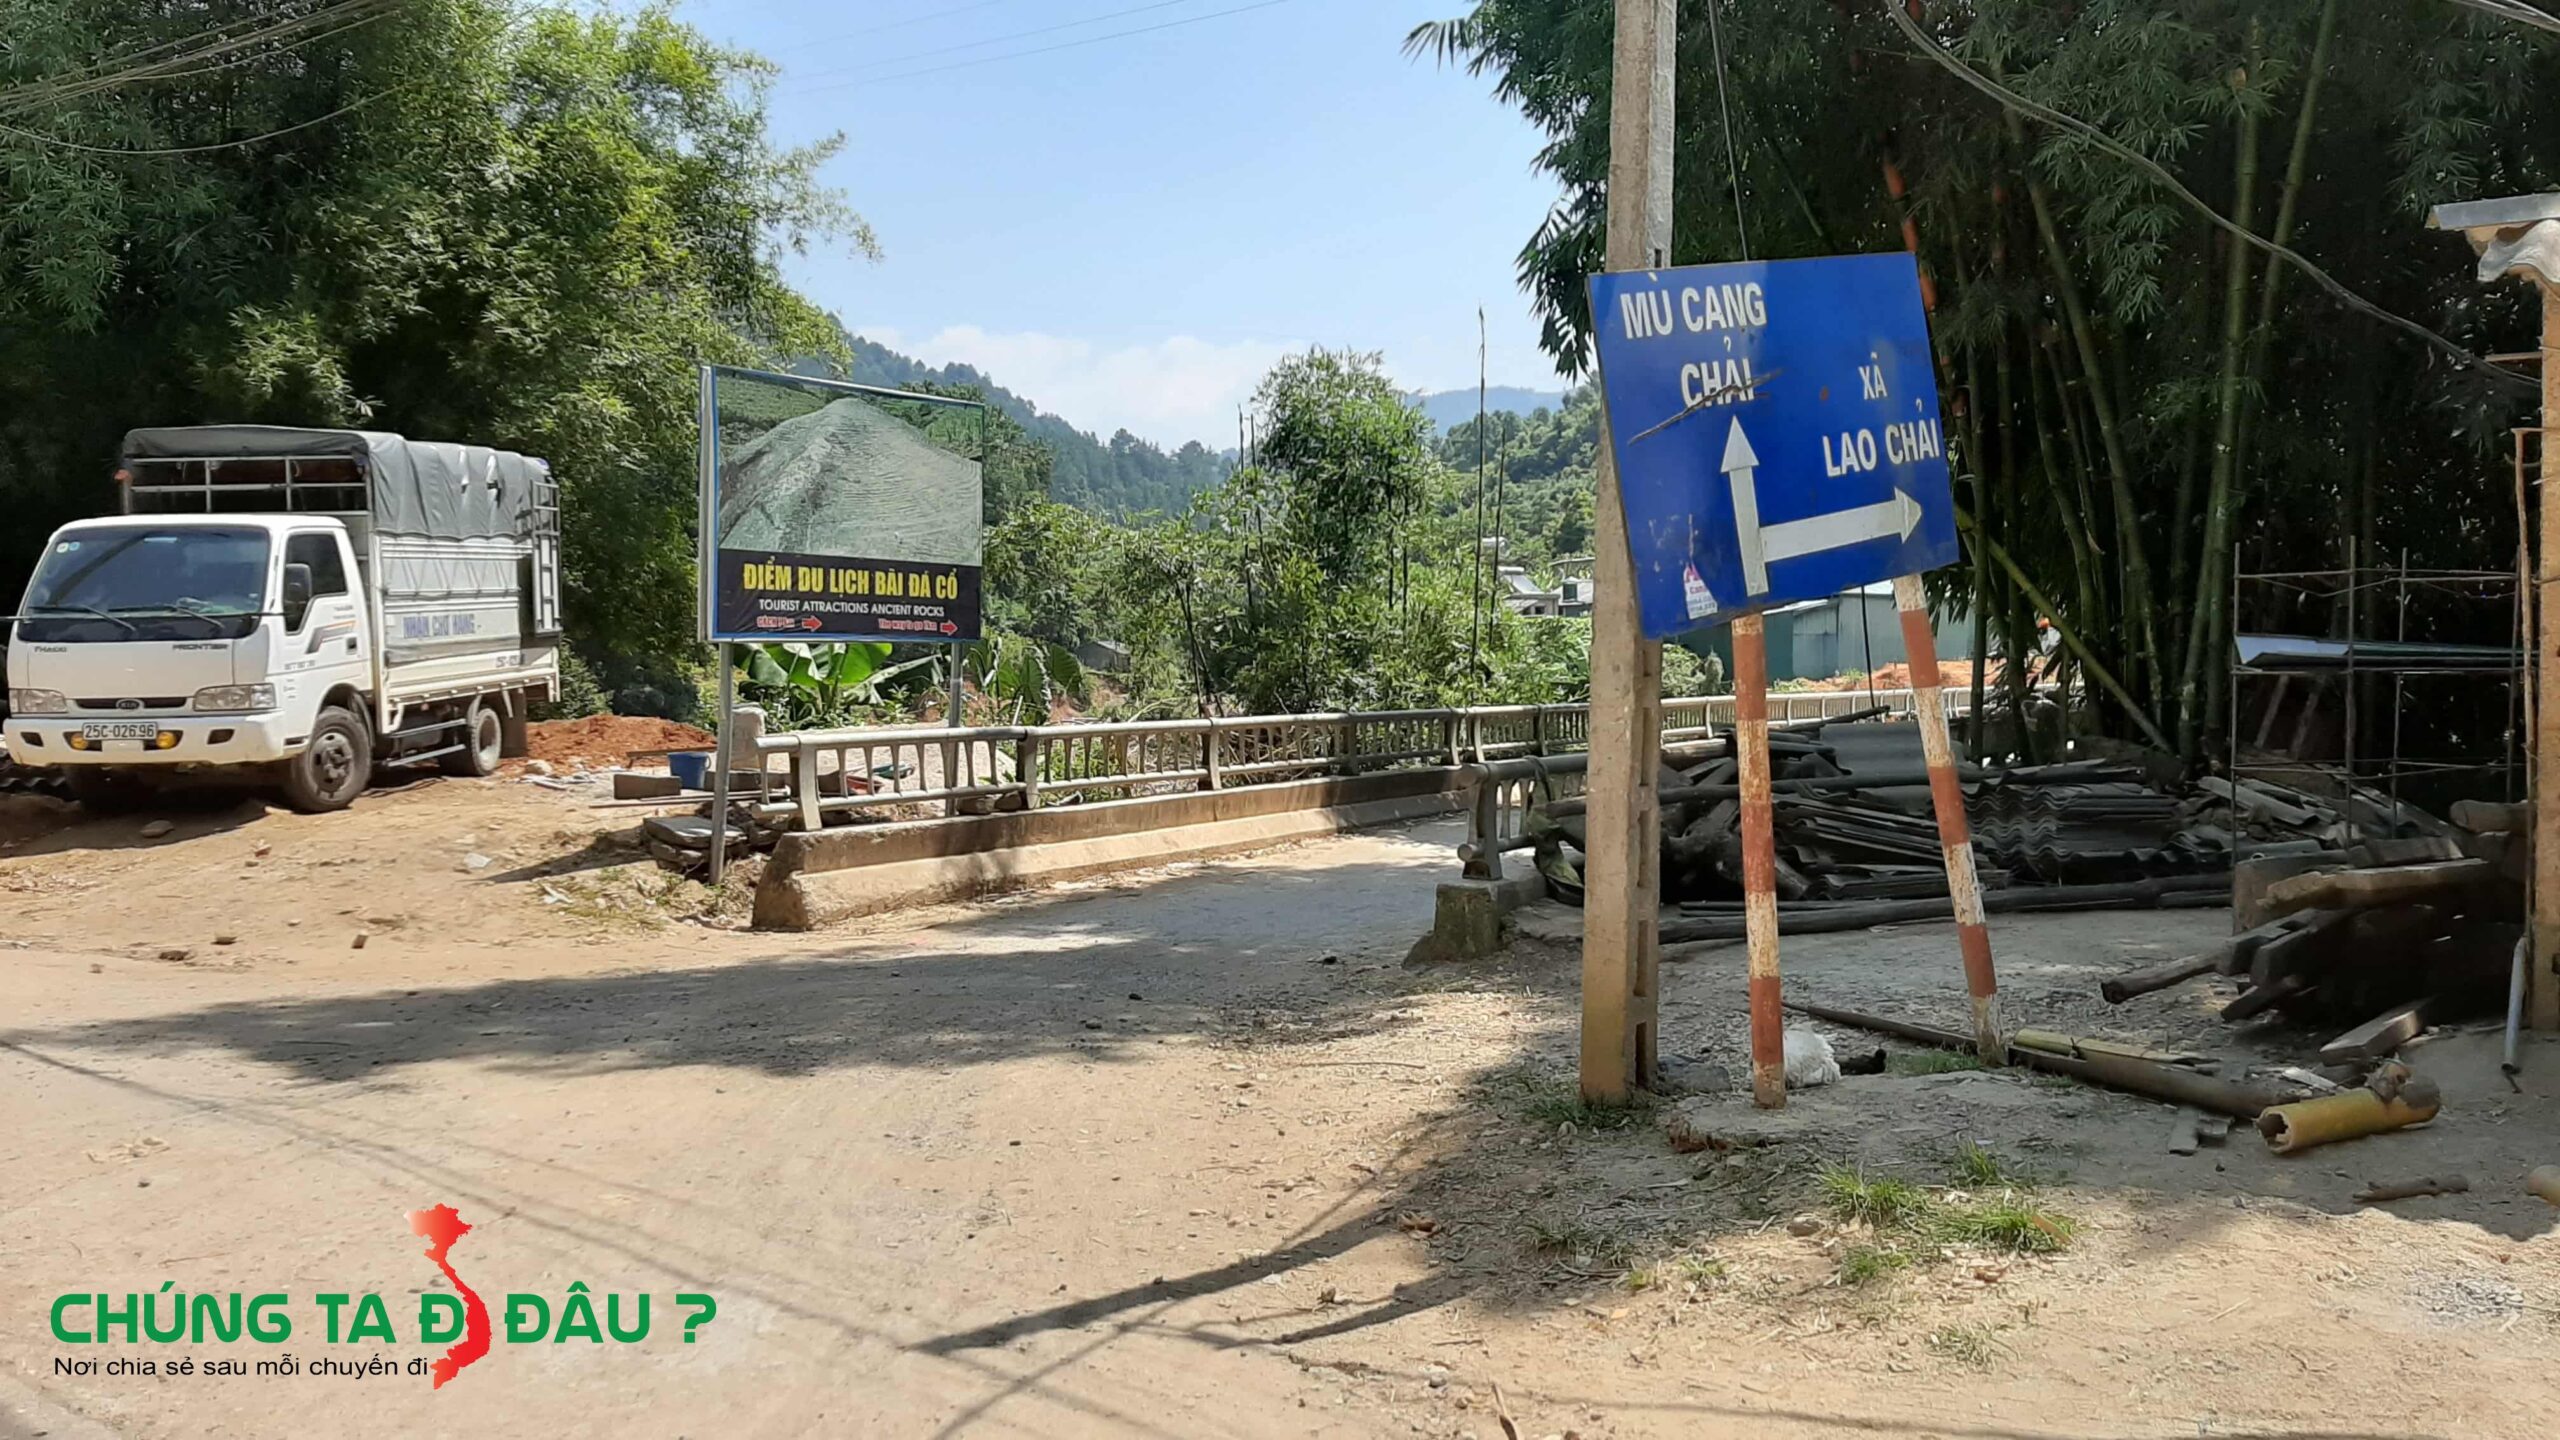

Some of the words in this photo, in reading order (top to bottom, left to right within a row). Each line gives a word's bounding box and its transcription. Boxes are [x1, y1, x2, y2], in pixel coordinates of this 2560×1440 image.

[1620, 273, 1674, 339] MÙ
[1822, 428, 1878, 478] LAO
[1885, 397, 1941, 466] CHẢI
[743, 555, 792, 591] ĐIỂM
[798, 566, 824, 592] DU
[830, 568, 869, 598] LỊCH
[908, 570, 931, 598] ĐÁ
[936, 568, 958, 600] CỔ
[759, 599, 800, 611] TOURIST
[802, 601, 869, 614] ATTRACTIONS
[871, 603, 912, 615] ANCIENT
[913, 605, 945, 617] ROCKS
